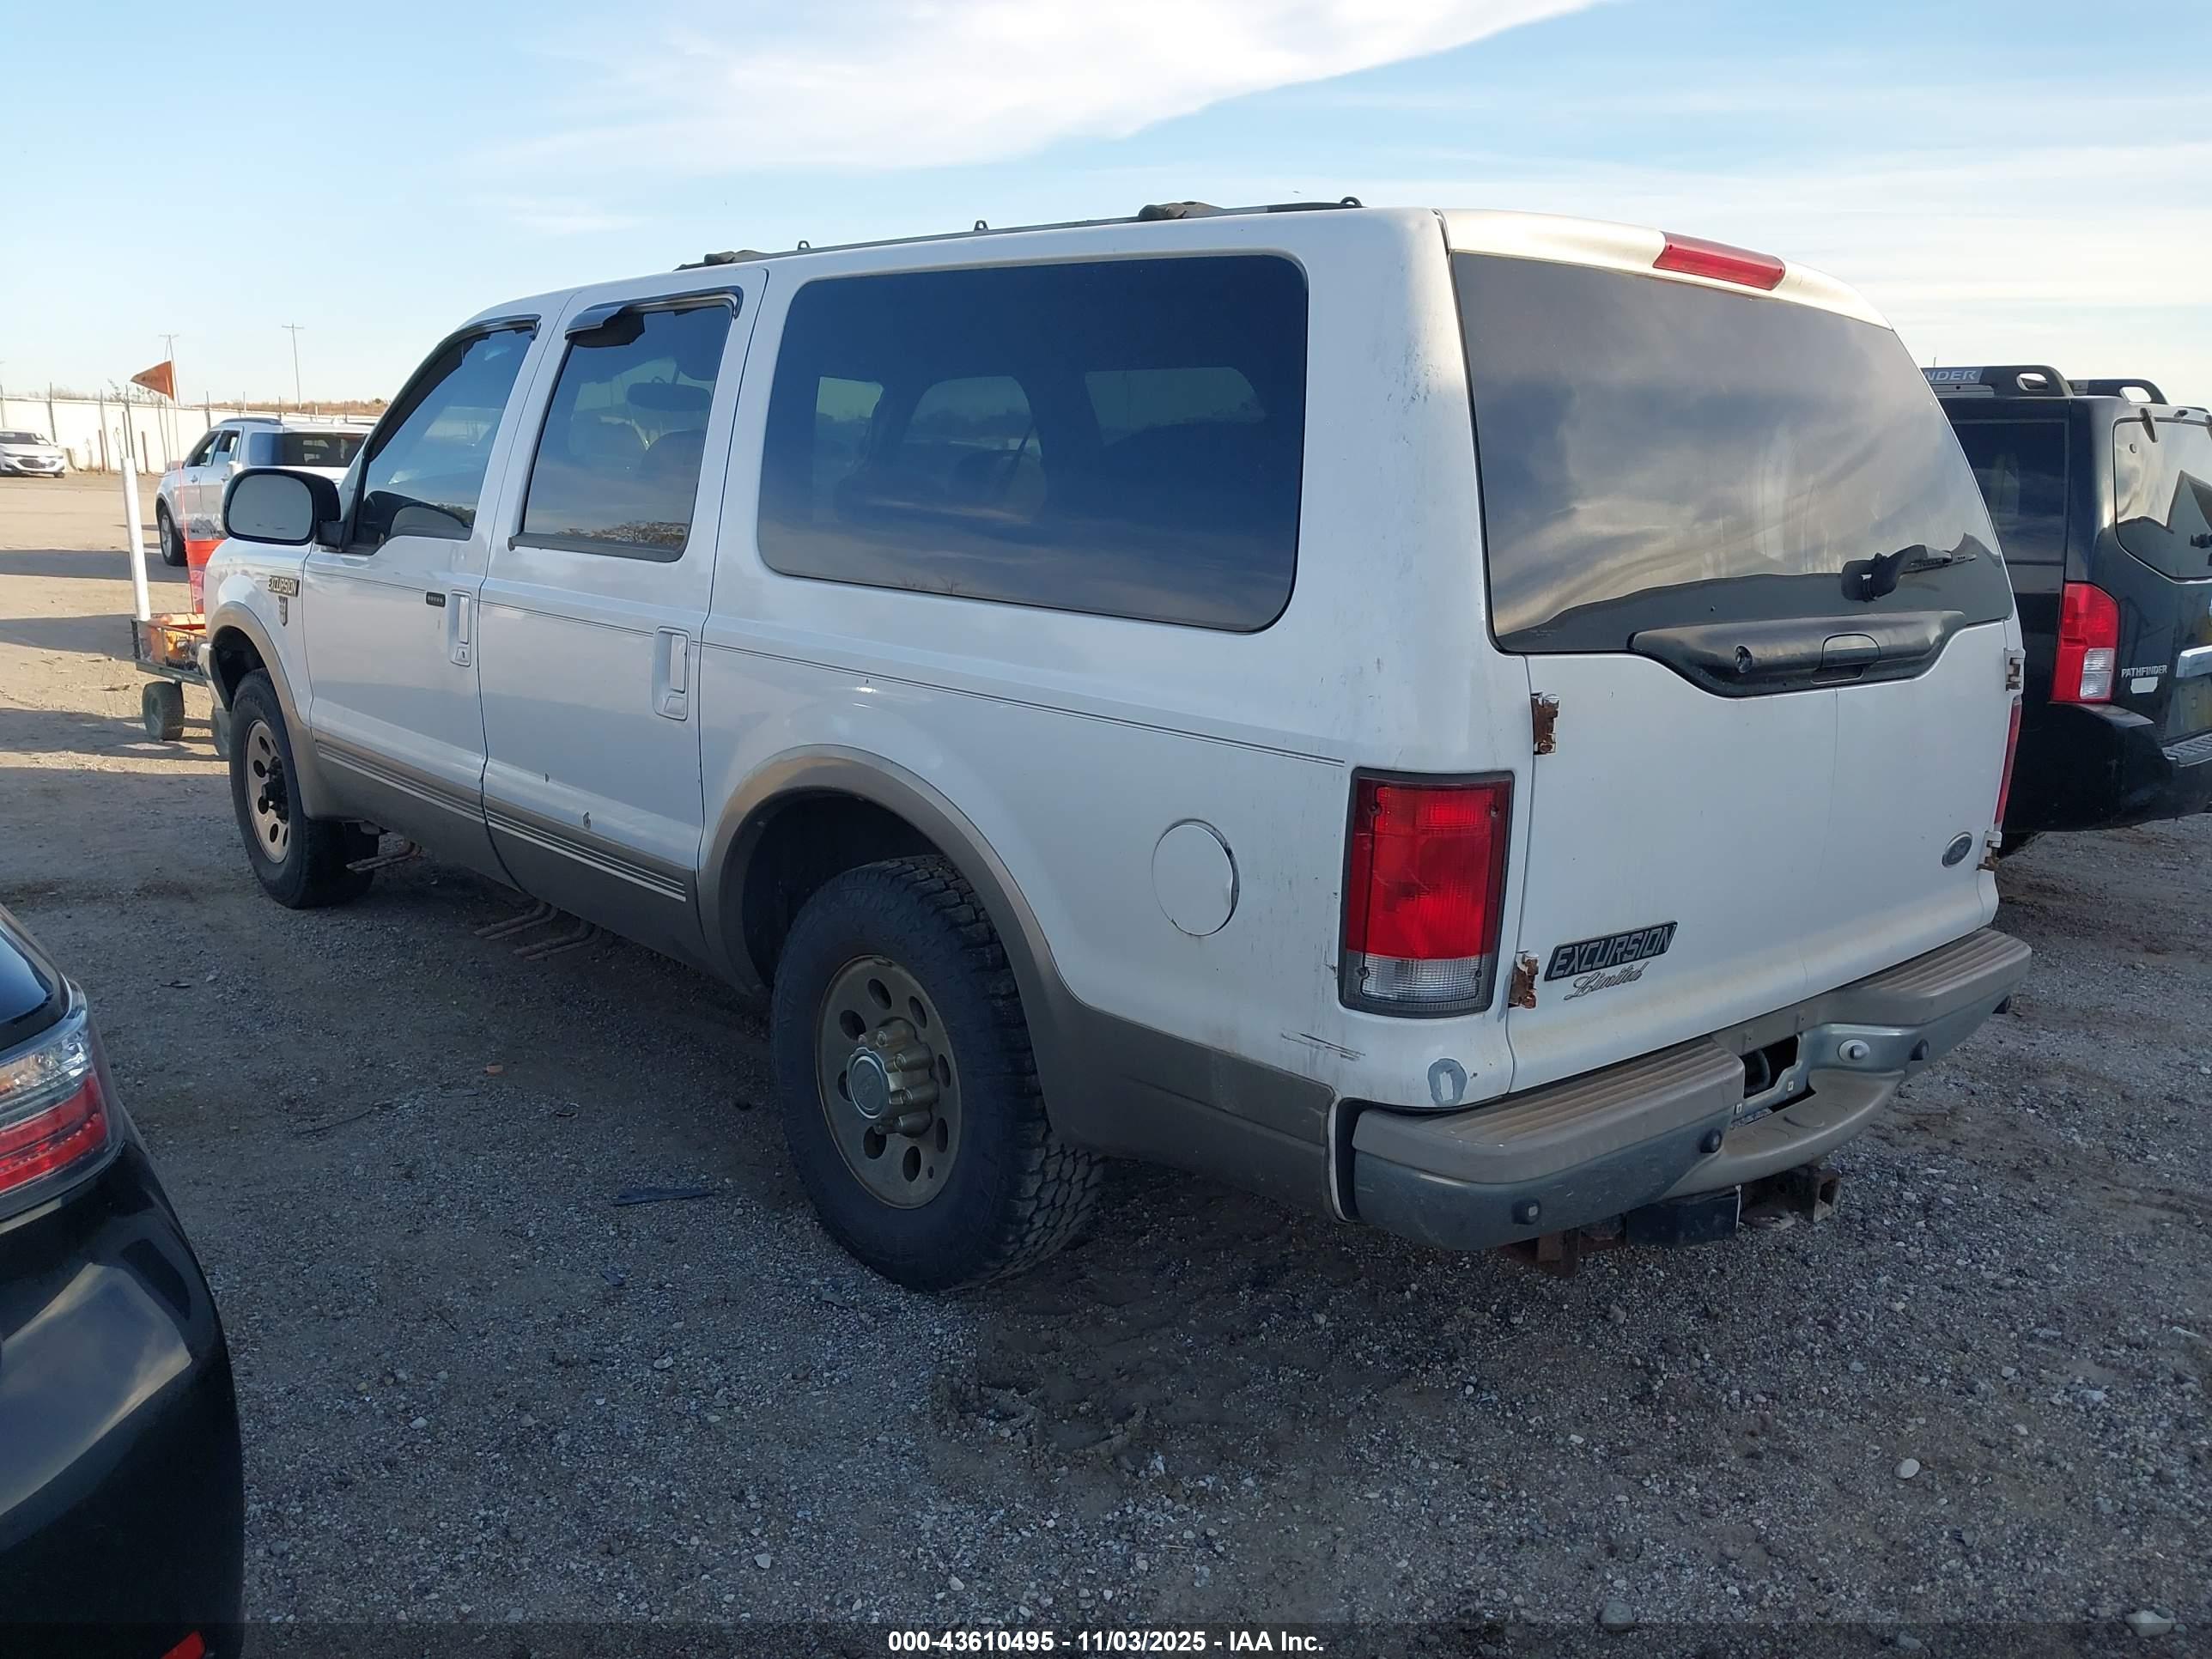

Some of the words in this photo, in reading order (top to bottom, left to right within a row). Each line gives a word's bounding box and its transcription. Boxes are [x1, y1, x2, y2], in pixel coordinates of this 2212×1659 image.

[2121, 665, 2167, 678] PATHFINDER
[1549, 923, 1677, 979] EXCURSION
[1564, 961, 1650, 1000] Limited
